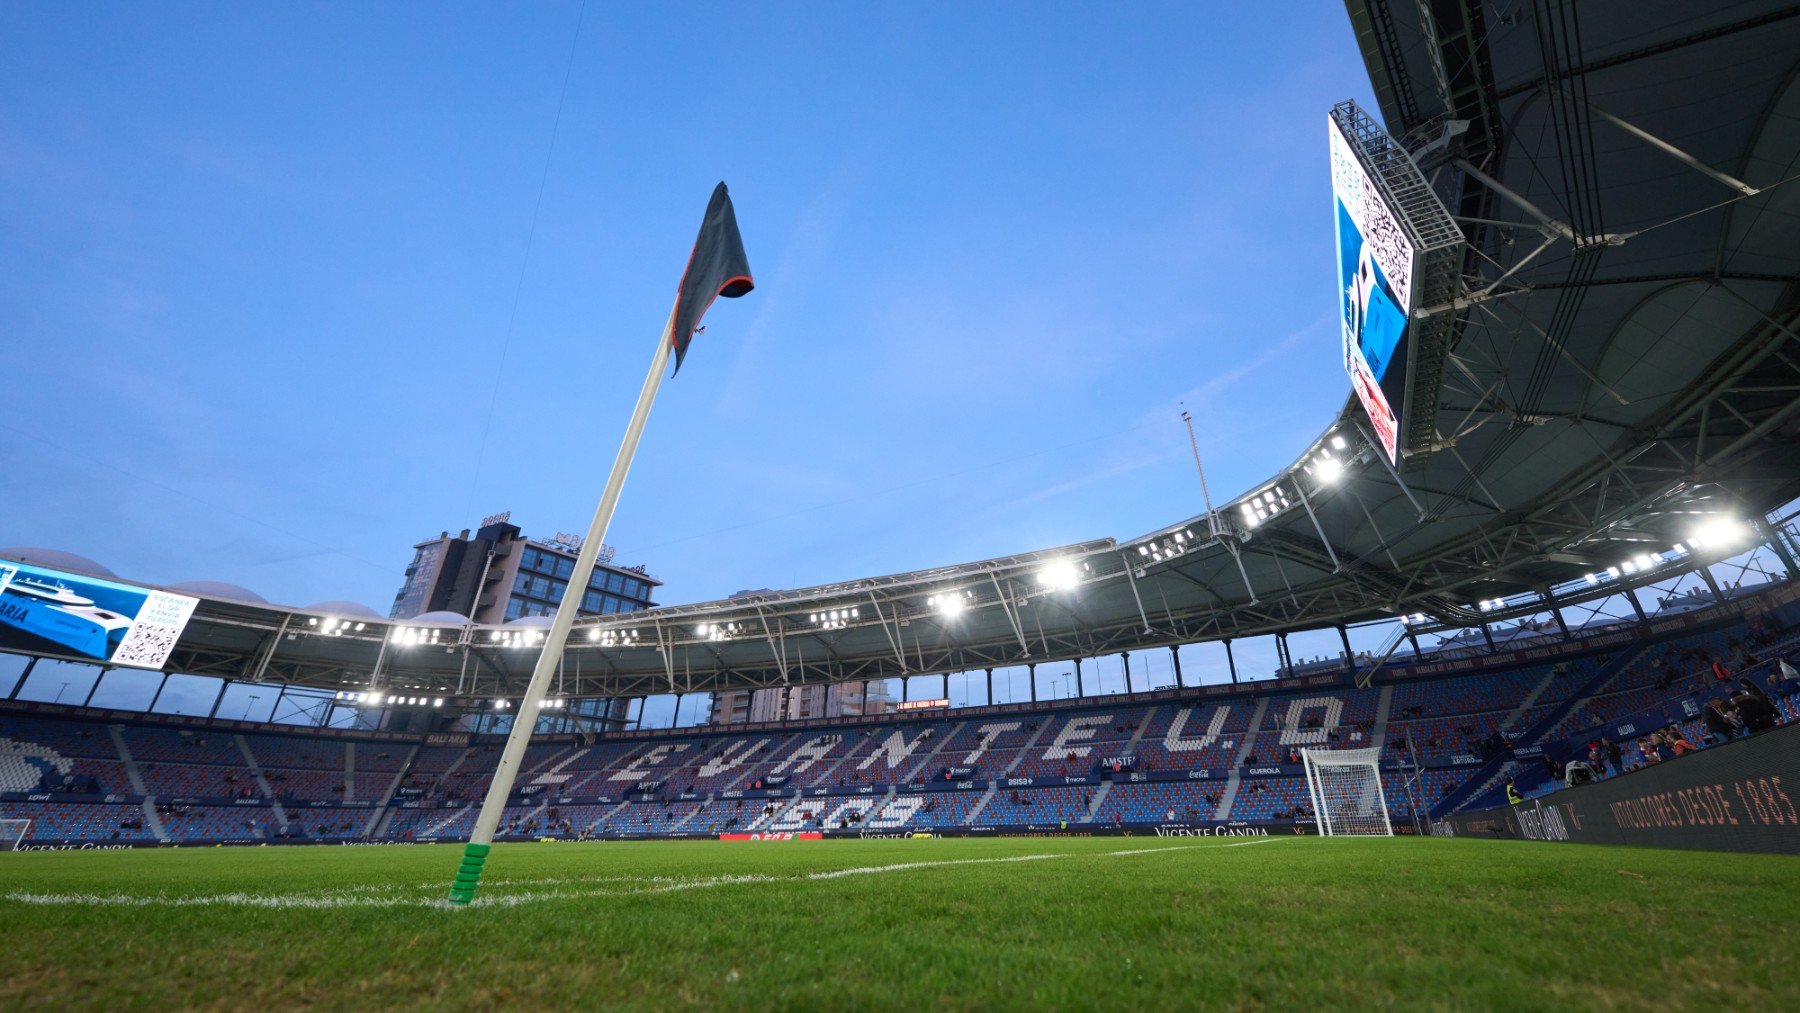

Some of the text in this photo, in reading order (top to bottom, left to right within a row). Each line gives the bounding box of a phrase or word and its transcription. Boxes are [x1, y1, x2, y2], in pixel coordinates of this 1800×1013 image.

[1250, 767, 1280, 775] GUEROLA
[722, 790, 743, 798] AMSTEL
[1677, 783, 1739, 826] DESDE
[1735, 775, 1799, 825] 1885
[1154, 825, 1269, 837] VICENTE GANDIA
